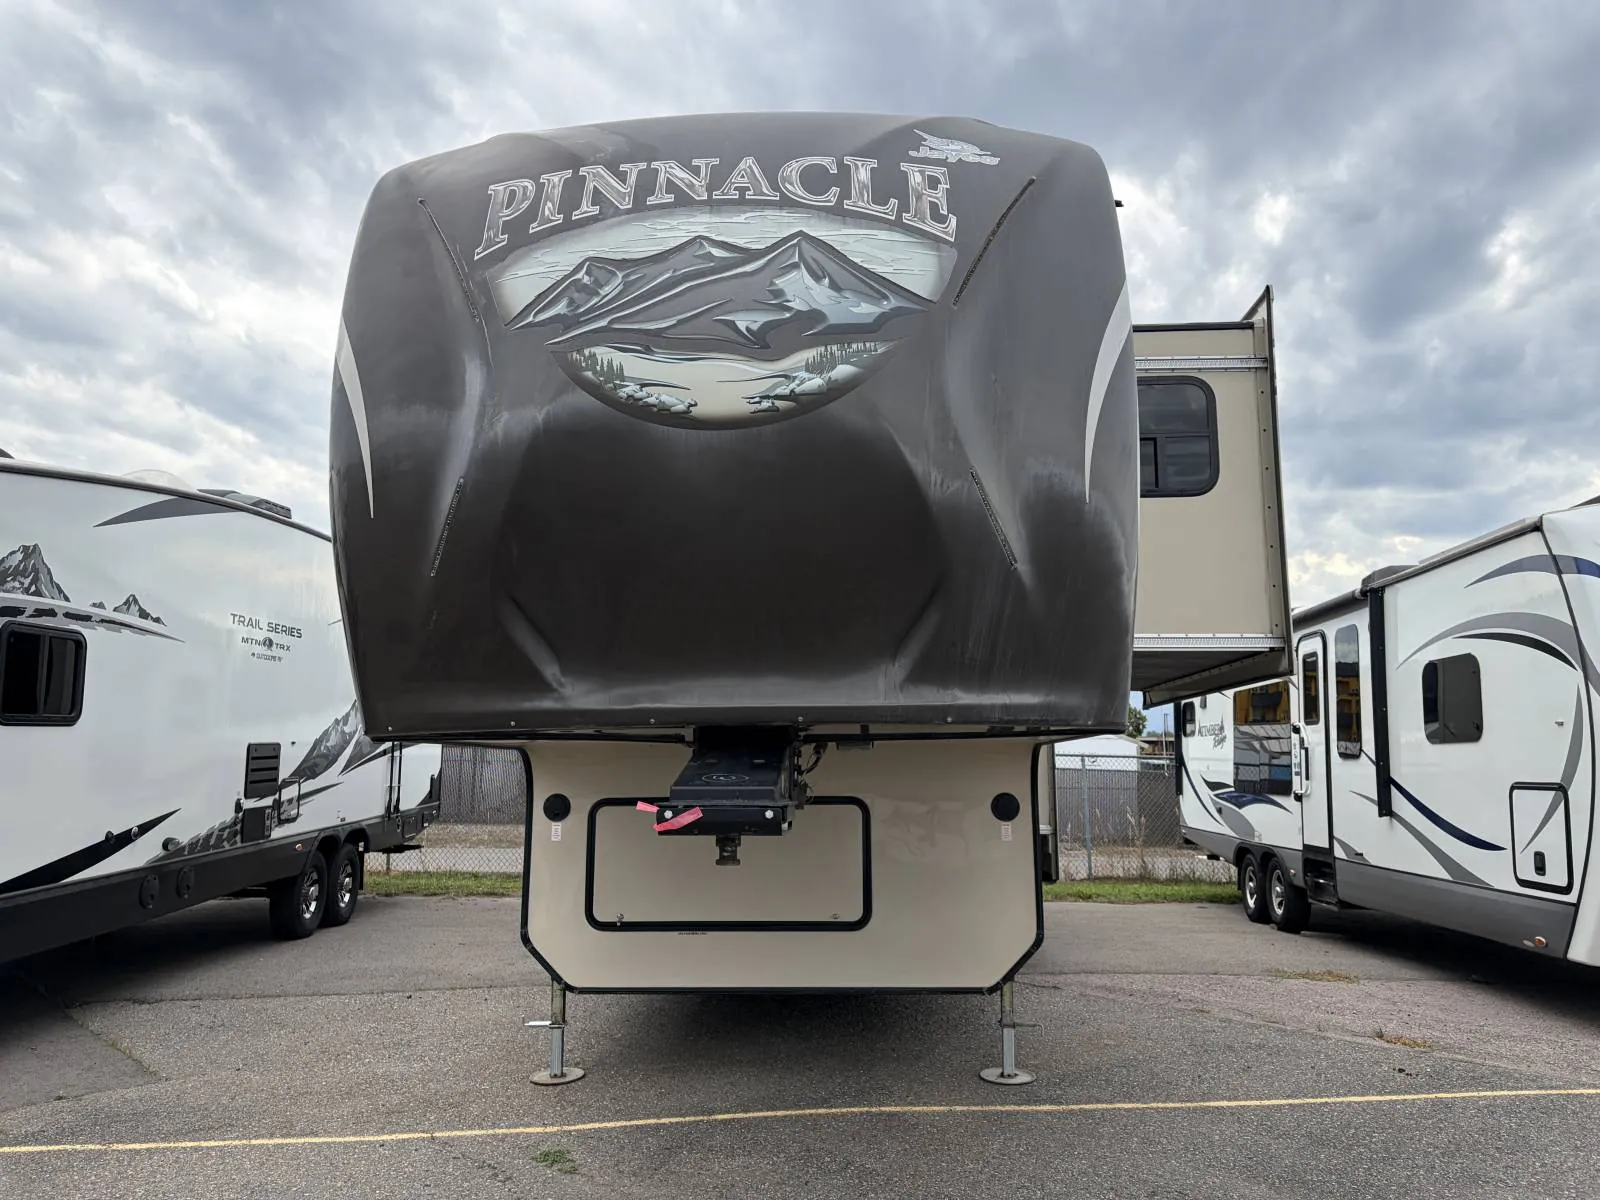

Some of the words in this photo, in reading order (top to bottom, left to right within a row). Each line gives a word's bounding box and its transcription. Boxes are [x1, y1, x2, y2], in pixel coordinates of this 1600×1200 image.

[908, 146, 1001, 166] Jayco
[474, 156, 957, 260] PINNACLE
[230, 612, 264, 630] TRAIL
[266, 621, 303, 639] SERIES
[241, 636, 263, 647] MTN
[274, 642, 291, 652] TRX
